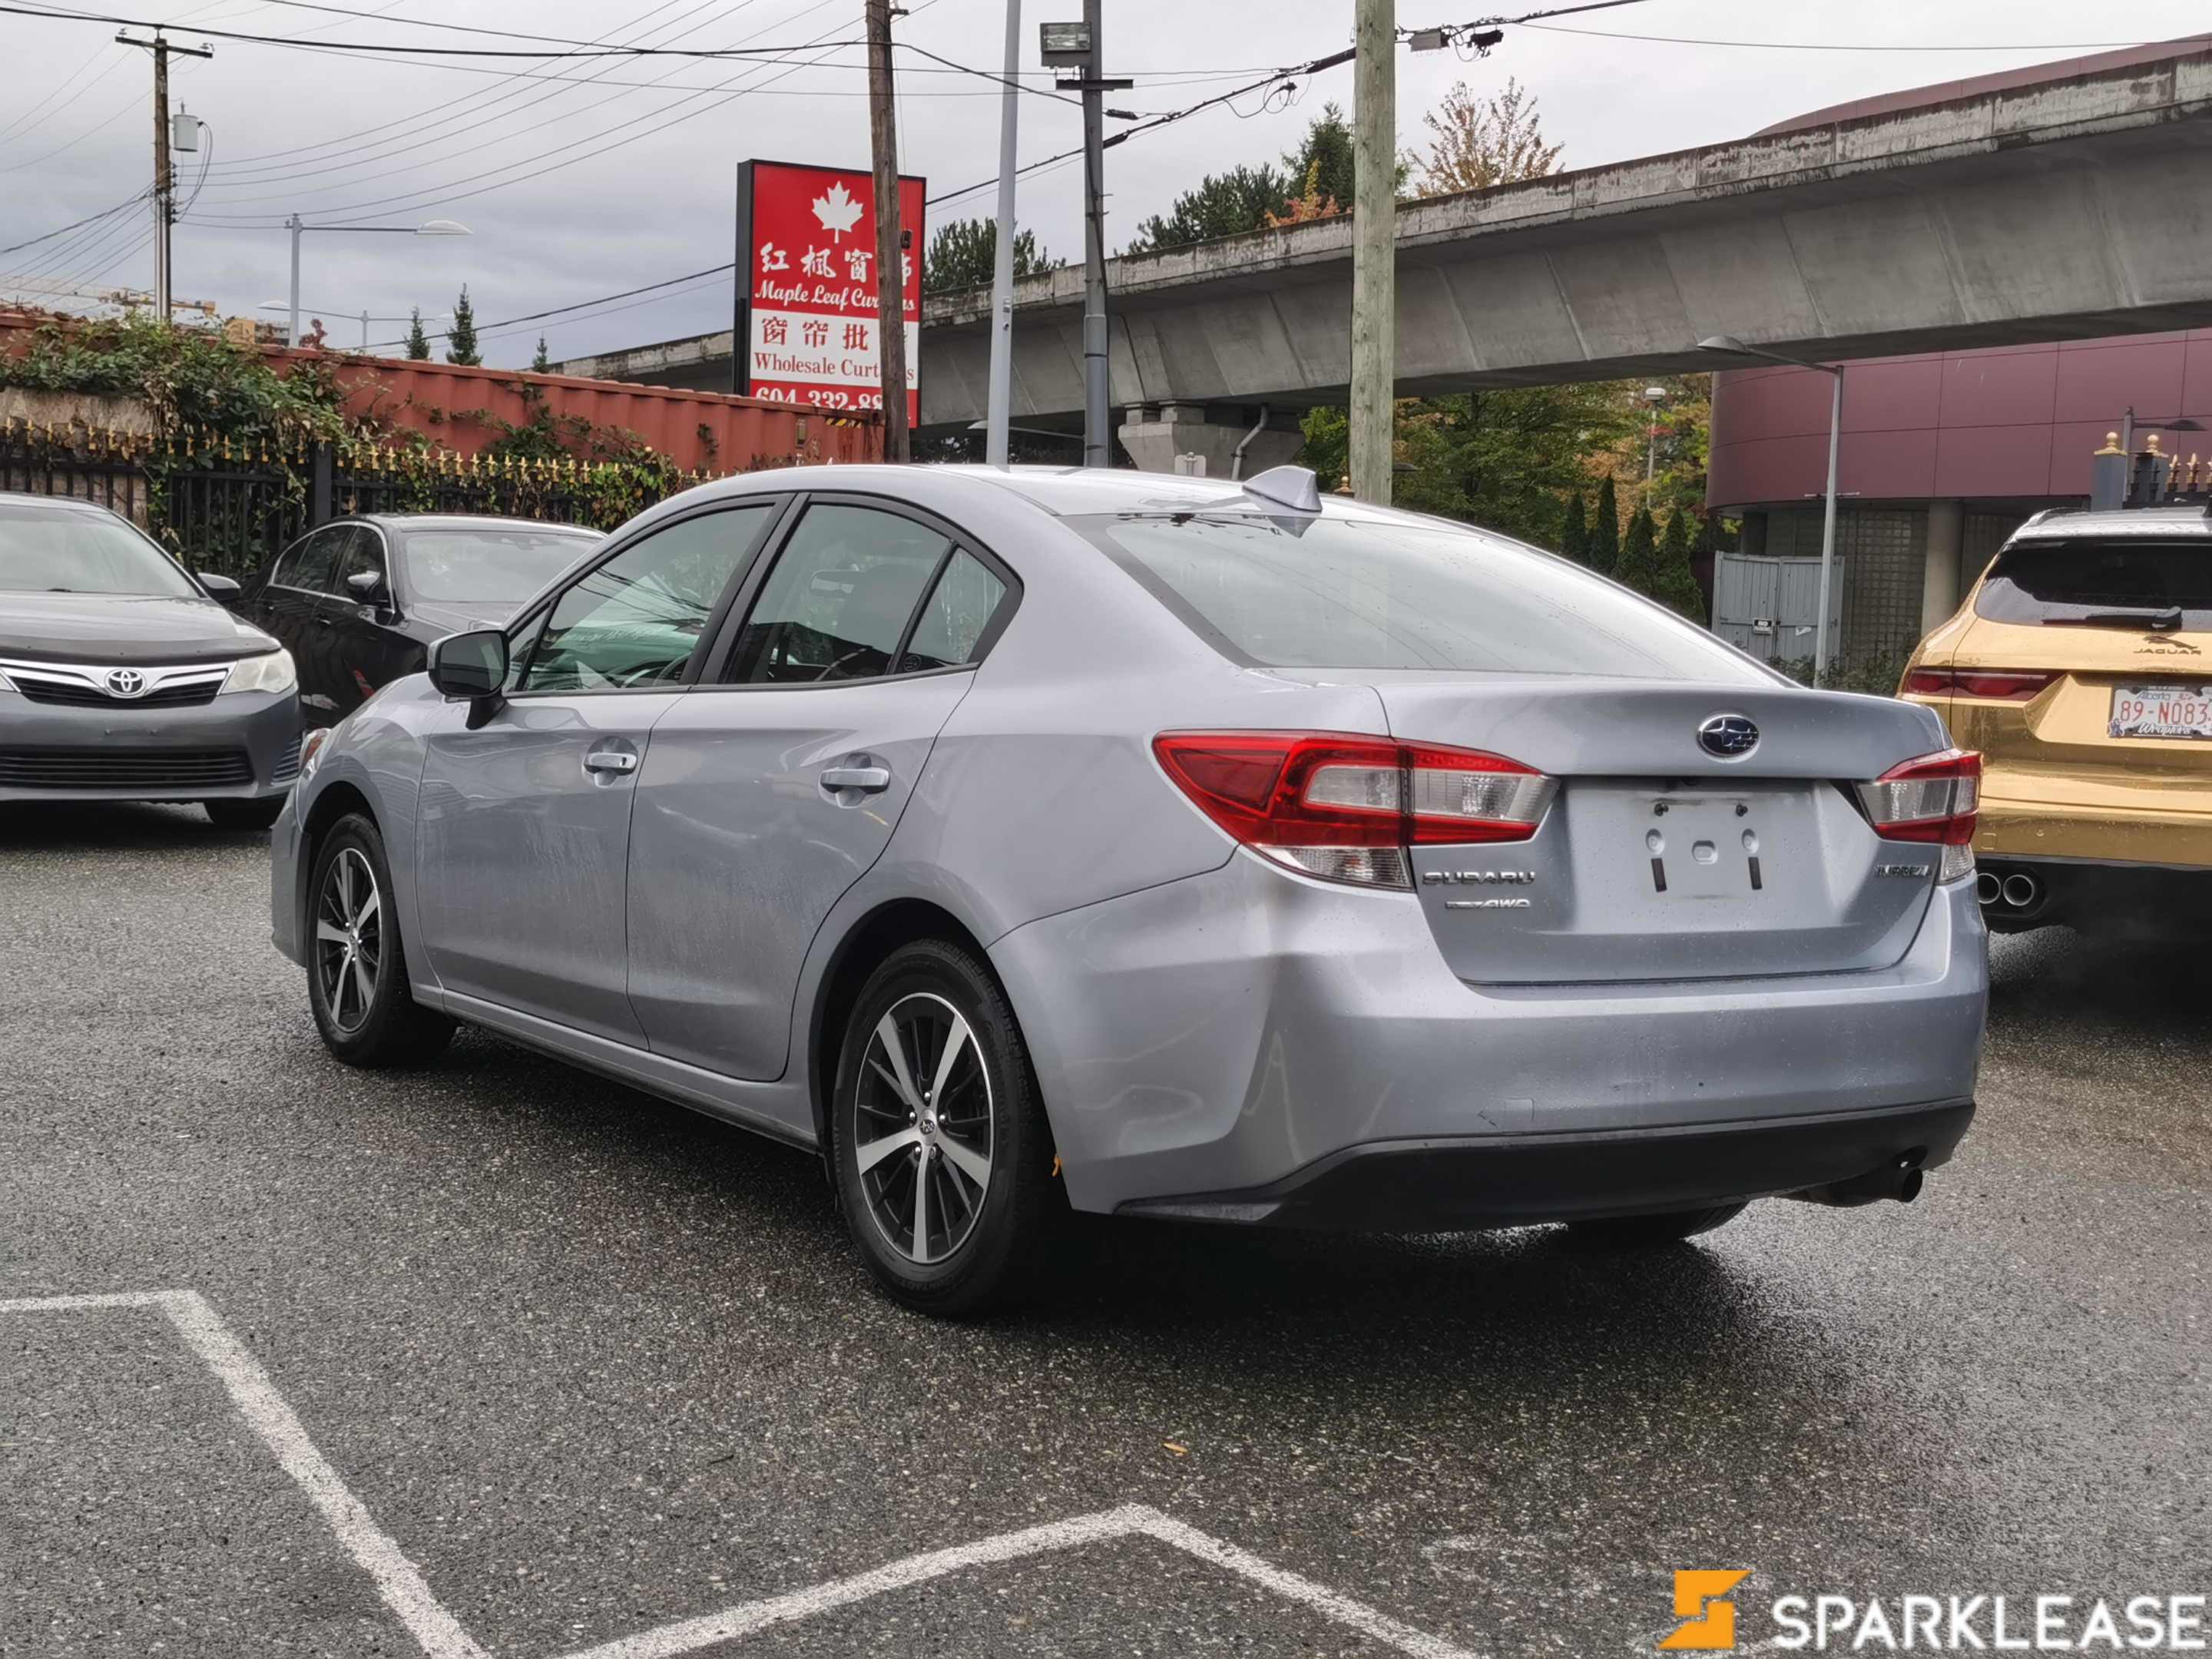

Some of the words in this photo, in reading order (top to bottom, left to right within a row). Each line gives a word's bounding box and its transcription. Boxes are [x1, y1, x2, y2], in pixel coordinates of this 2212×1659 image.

[755, 280, 809, 306] Maple
[811, 285, 849, 311] Leaf
[762, 316, 869, 351] 窗帘批
[755, 353, 836, 375] Wholesale
[841, 359, 914, 380] Curts
[1422, 871, 1536, 885] SUBARU
